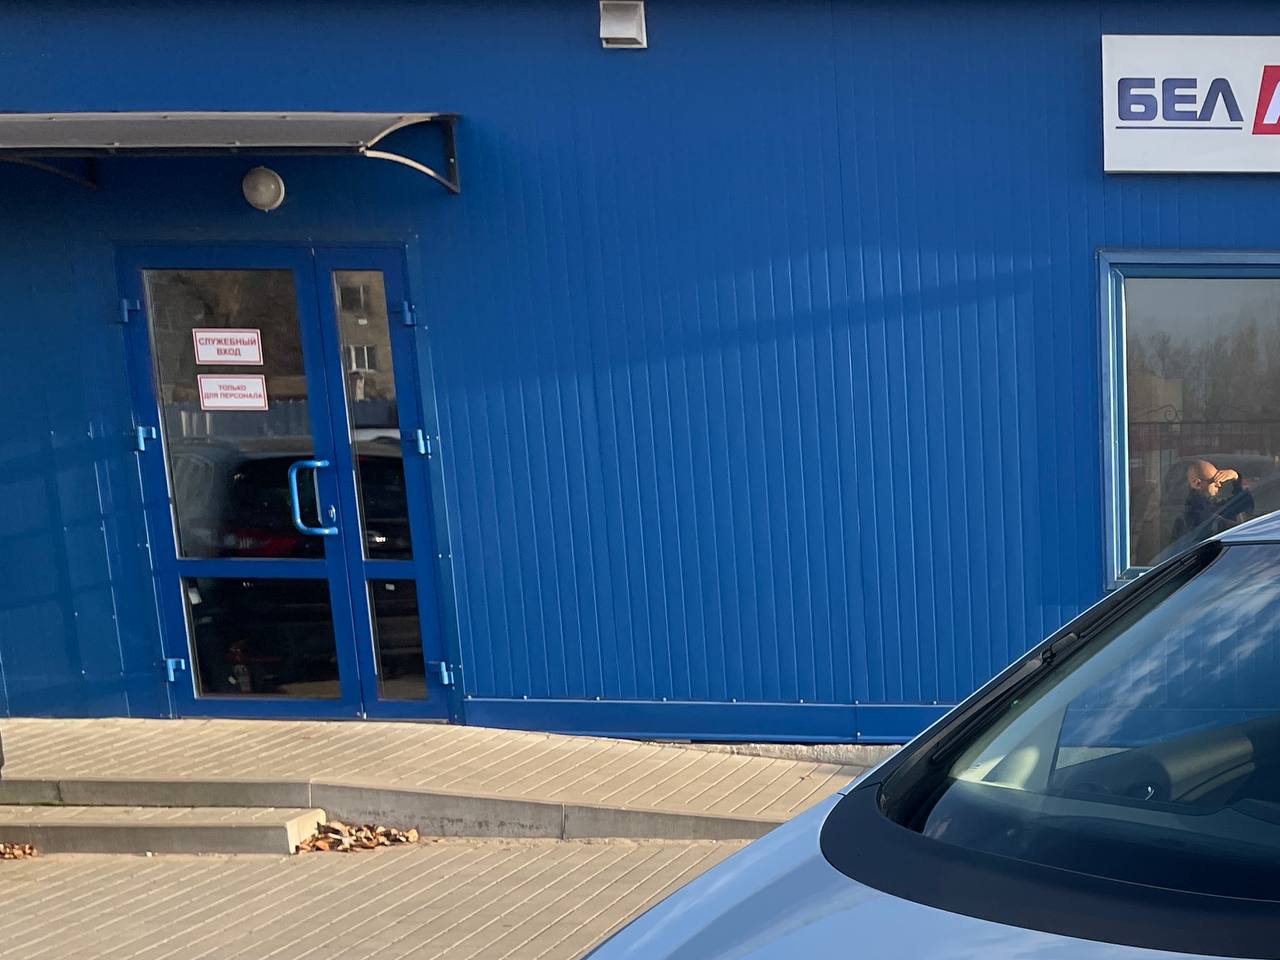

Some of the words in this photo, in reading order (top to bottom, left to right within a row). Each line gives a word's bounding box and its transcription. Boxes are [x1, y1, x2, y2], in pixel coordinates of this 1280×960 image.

[1116, 77, 1244, 122] БЕЛ
[198, 337, 257, 346] СЛУЖЕБНЫЙ
[216, 347, 242, 356] ВХОД
[218, 384, 247, 392] ТОЛЬКО
